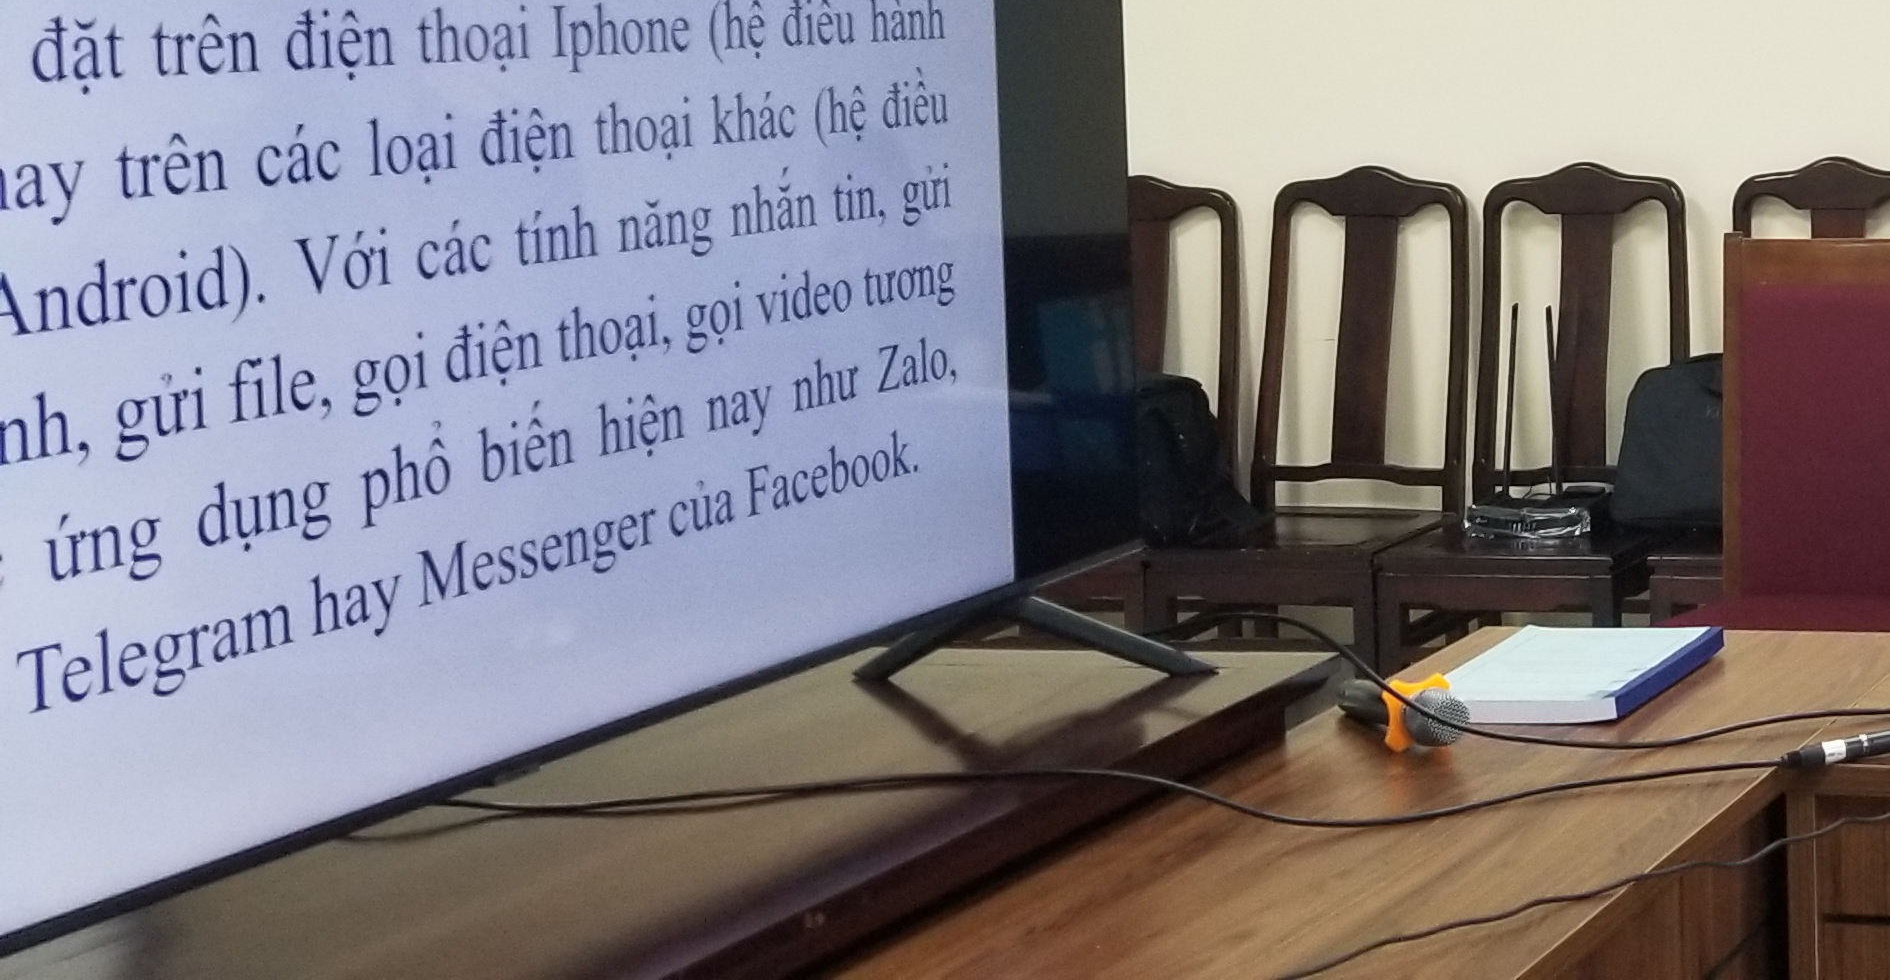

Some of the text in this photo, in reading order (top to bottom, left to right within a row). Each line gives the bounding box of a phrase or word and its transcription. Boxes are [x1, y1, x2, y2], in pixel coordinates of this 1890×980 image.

[32, 16, 124, 95] đặt
[151, 13, 259, 76] trên
[285, 9, 395, 81] điện
[417, 5, 529, 72] thoại
[552, 3, 689, 73] Iphone
[709, 0, 765, 62] (hệ
[0, 67, 948, 226] ay trên các loại điện thoại khác (hệ điều
[293, 227, 391, 294] Với
[417, 219, 491, 280] các
[515, 204, 598, 266] tính
[618, 200, 713, 257] năng
[731, 167, 817, 237] nhắn
[833, 174, 886, 224] tin,
[903, 163, 951, 227] gửi
[115, 367, 208, 462] gửi
[229, 354, 332, 423] file,
[352, 331, 428, 417] gọi
[445, 319, 543, 386] điện
[556, 294, 673, 362] thoại,
[686, 281, 743, 354] gọi
[756, 270, 852, 324] video
[864, 263, 955, 306] tương
[43, 513, 162, 581] ứng
[197, 481, 331, 552] dụng
[361, 421, 451, 529] phổ
[478, 400, 575, 482] biến
[598, 394, 684, 457] hiện
[706, 386, 771, 436] nay
[793, 359, 858, 412] như
[878, 337, 956, 393] Zalo,
[16, 431, 920, 713] Telegram hay Messenger của Facebook.
